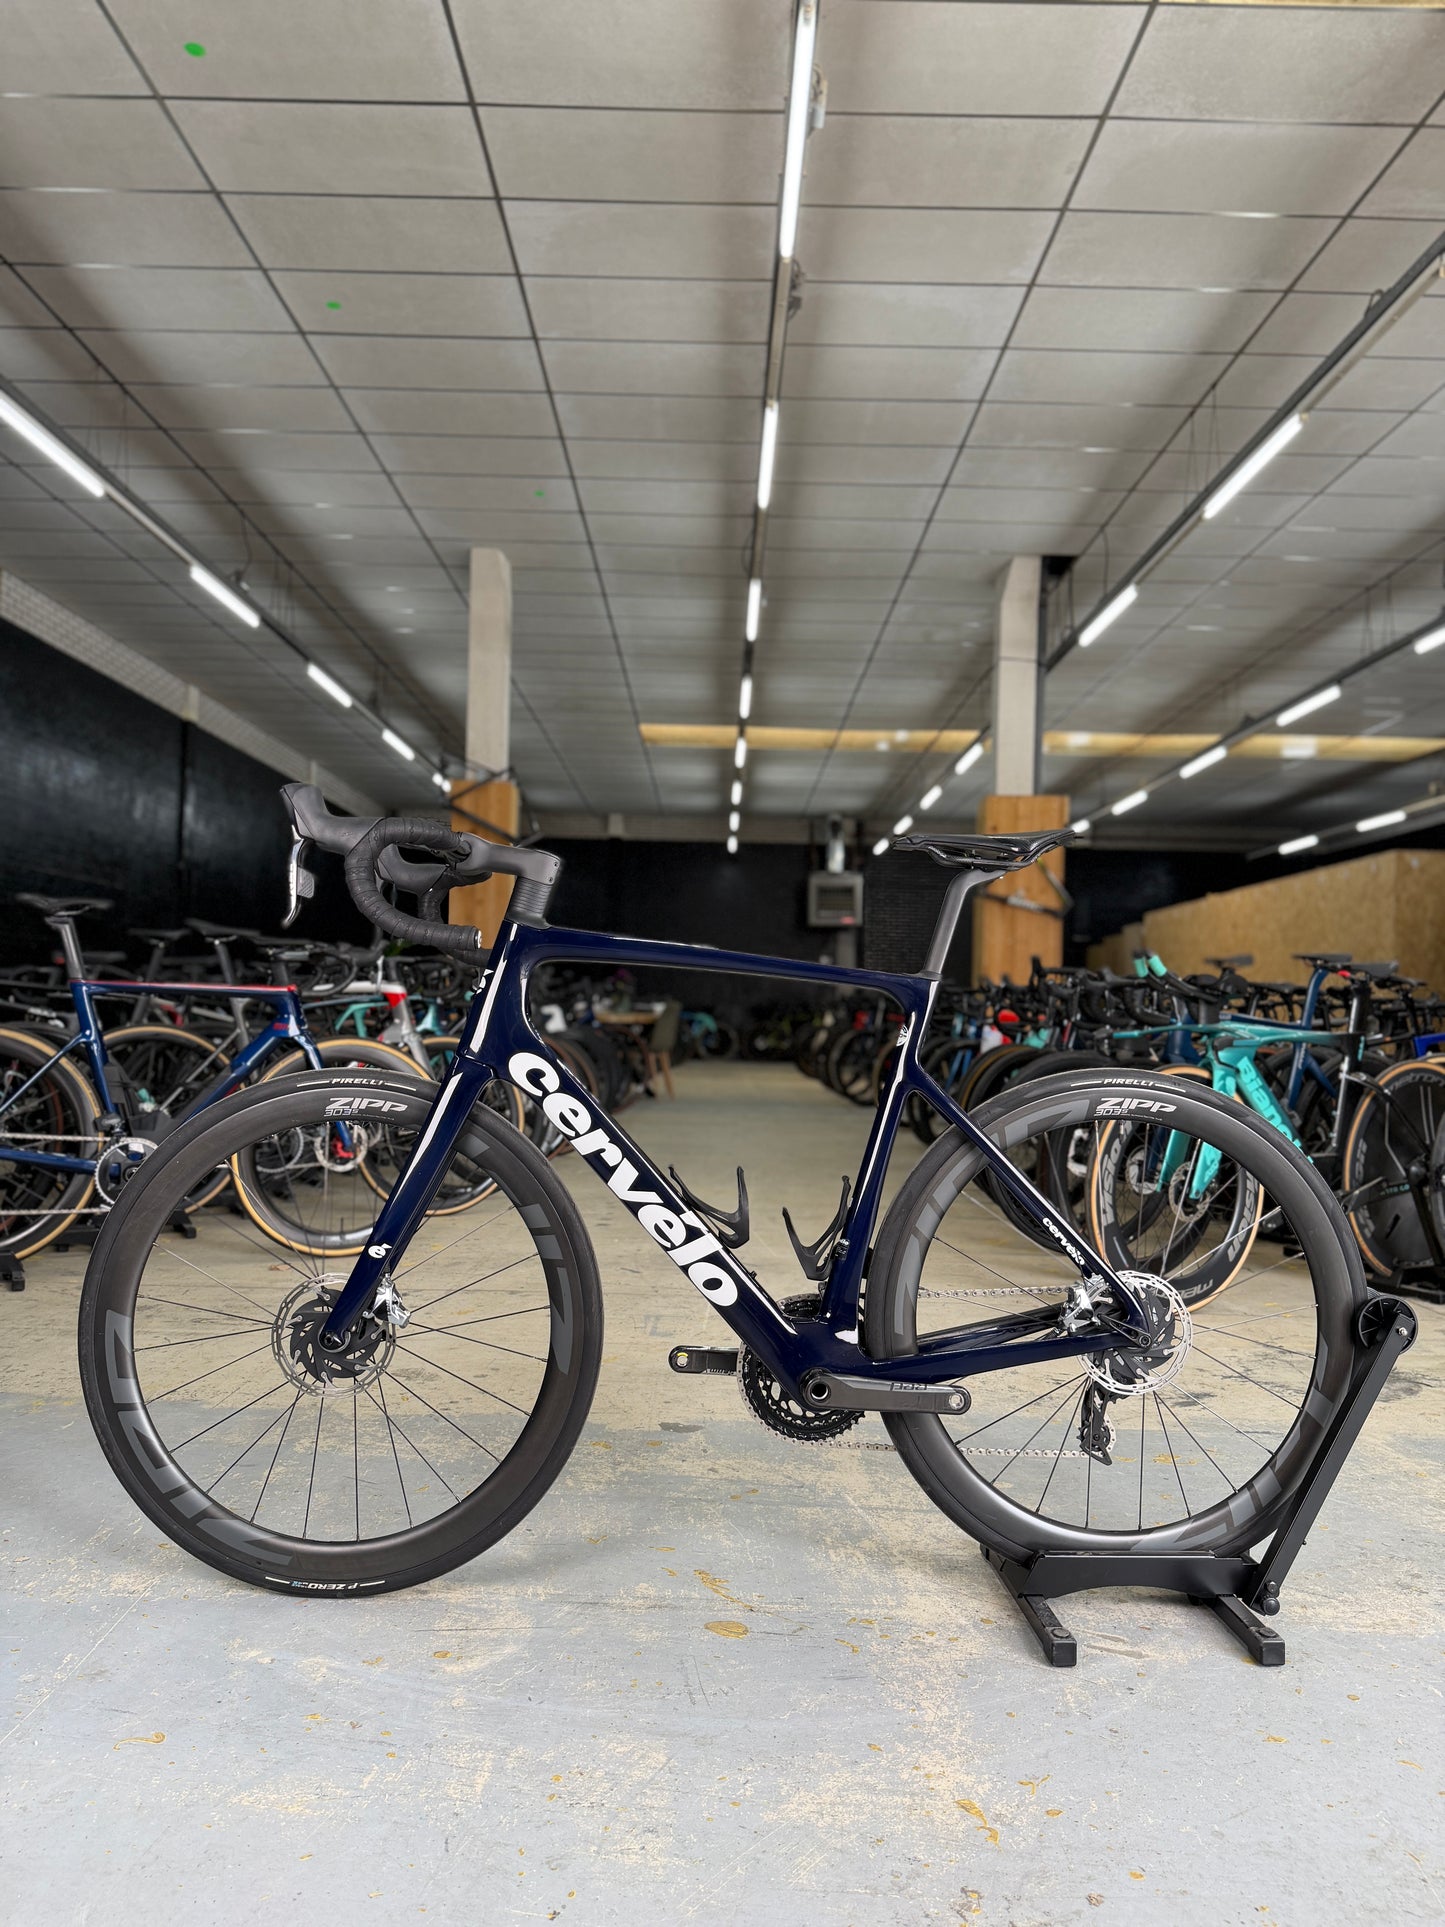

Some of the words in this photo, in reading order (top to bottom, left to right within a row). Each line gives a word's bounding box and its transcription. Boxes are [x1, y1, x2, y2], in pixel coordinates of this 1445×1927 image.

[332, 1078, 383, 1086] PIRELLI
[1103, 1078, 1154, 1087] PIRELLI
[326, 1097, 408, 1112] ZIPP
[1096, 1097, 1178, 1113] ZIPP
[508, 1052, 738, 1306] cervélo
[1042, 1217, 1085, 1266] cervélo
[307, 1582, 347, 1591] ZERO
